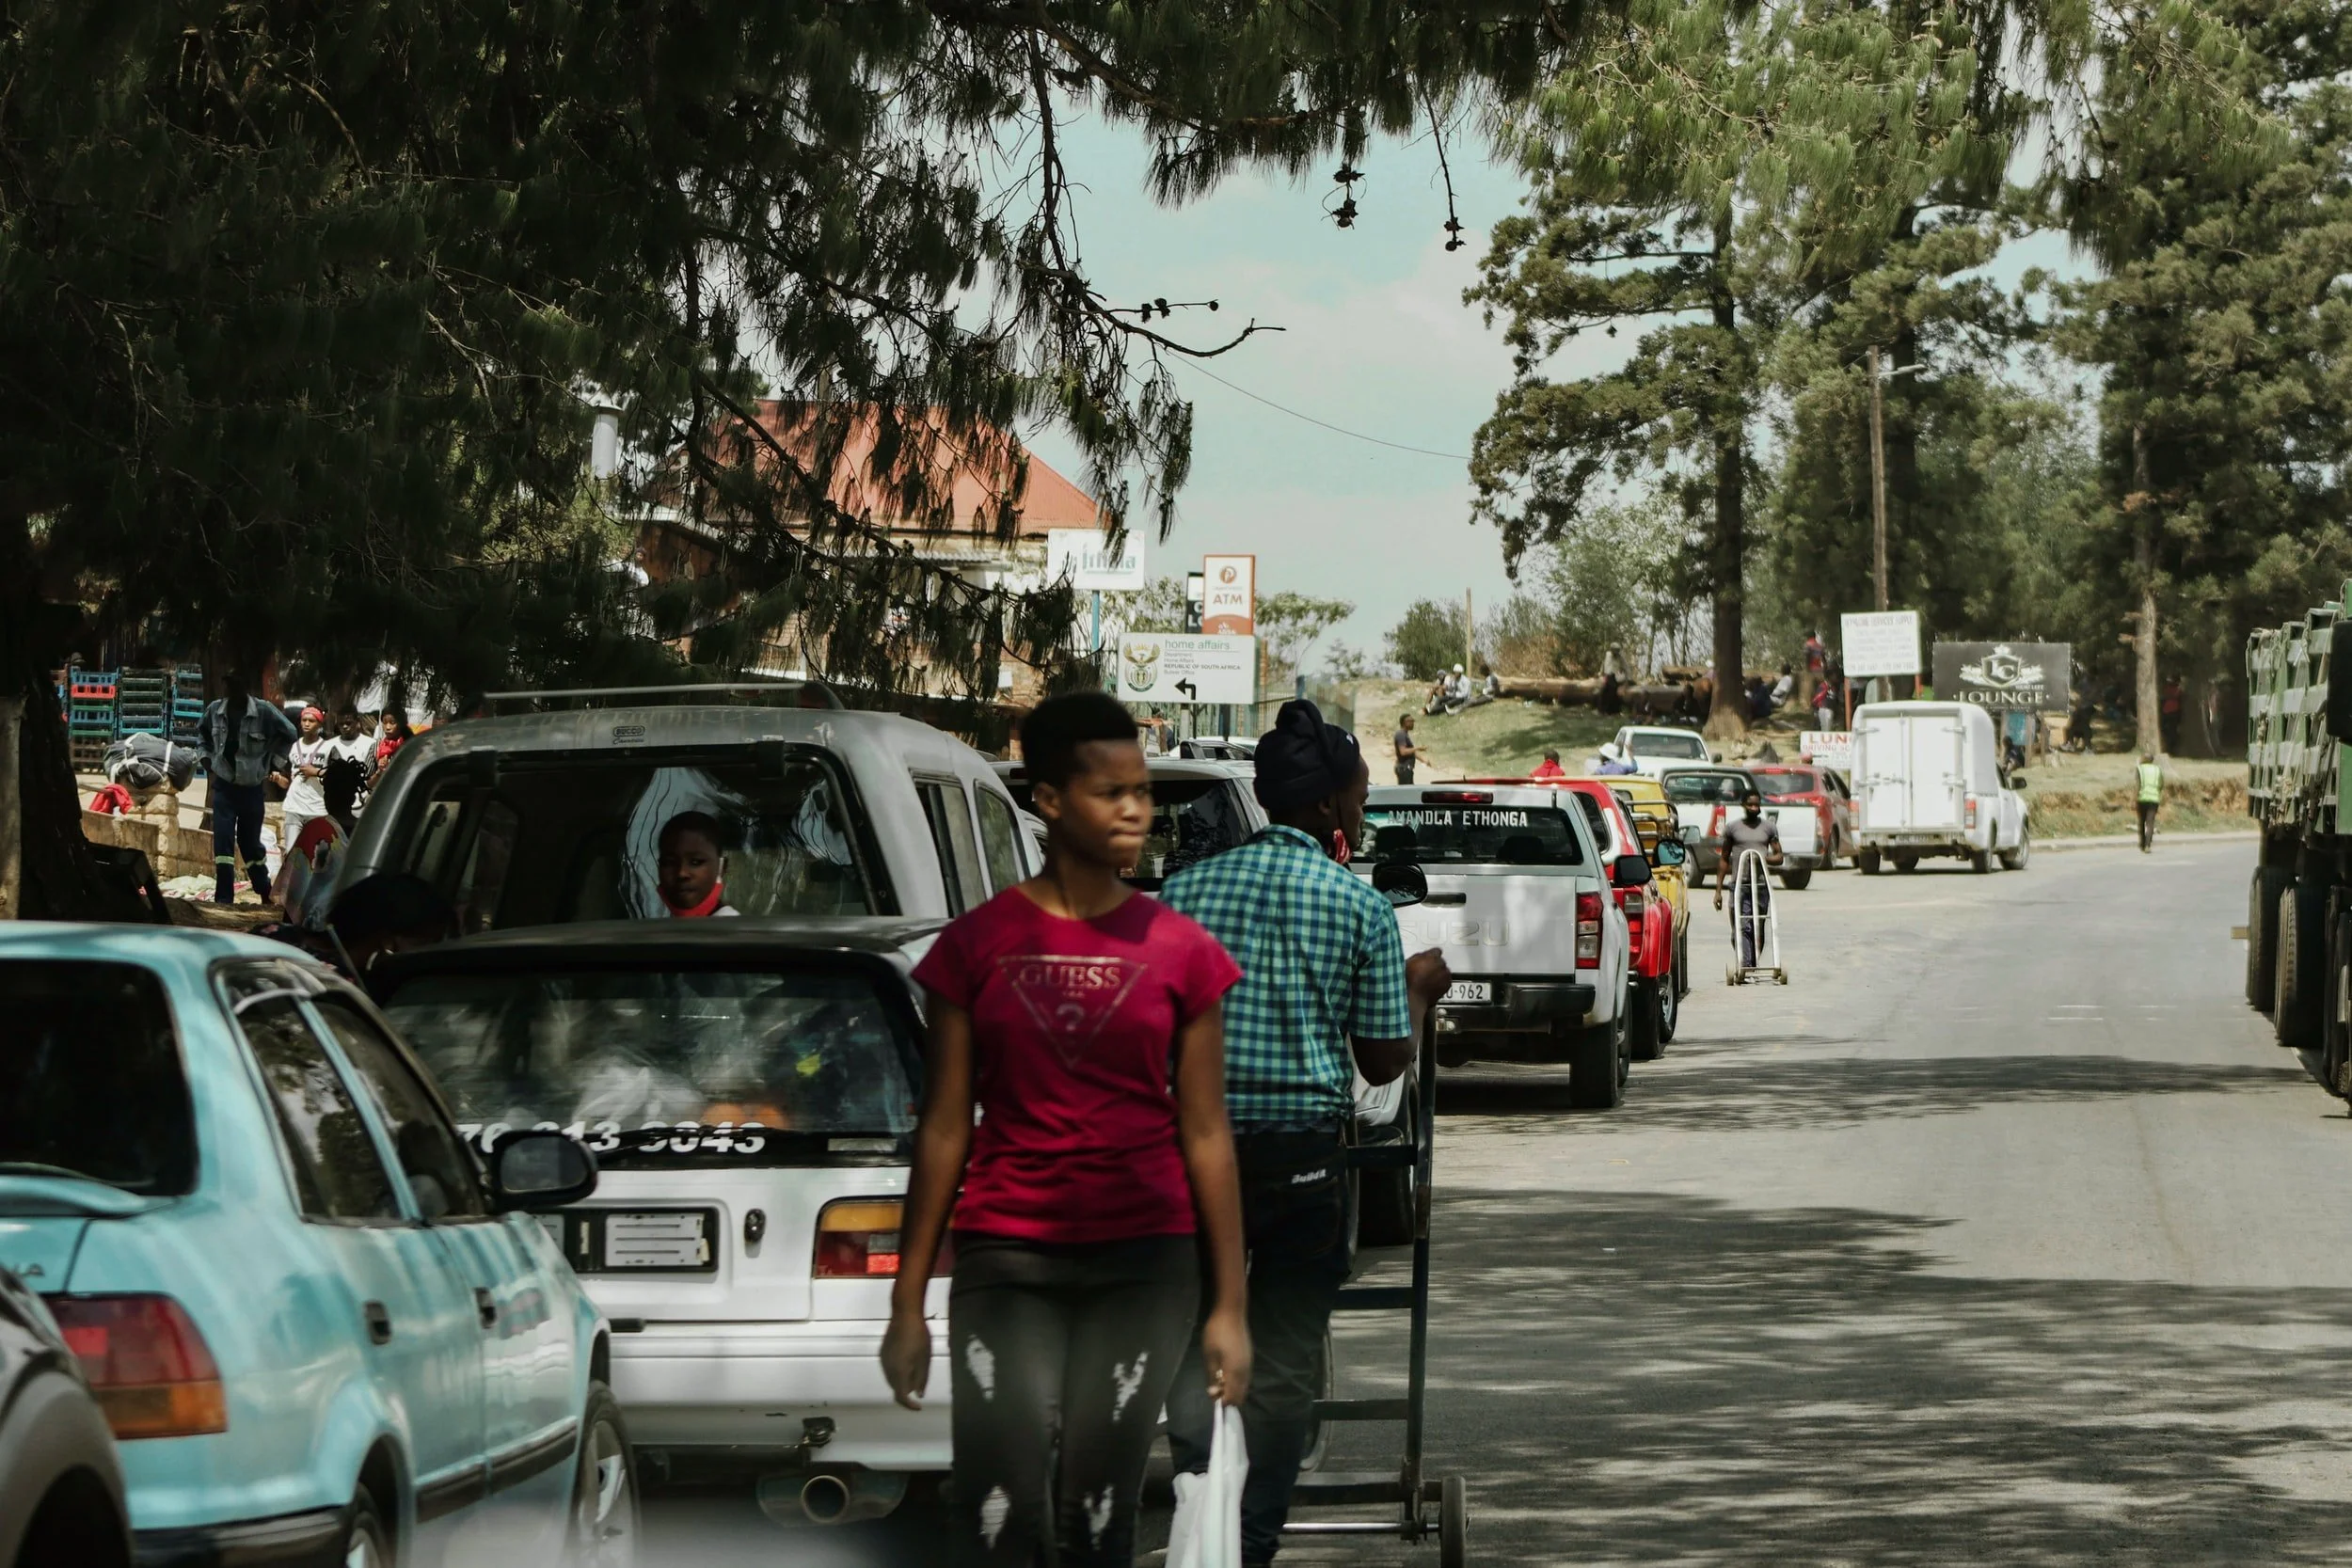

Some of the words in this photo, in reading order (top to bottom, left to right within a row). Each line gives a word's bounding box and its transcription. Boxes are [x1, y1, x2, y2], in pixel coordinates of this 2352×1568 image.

[1213, 594, 1243, 605] ATM
[1165, 640, 1195, 649] home
[1198, 640, 1231, 650] affairs
[1808, 734, 1851, 744] LUN
[1387, 810, 1453, 826] AMANDLA
[1462, 811, 1529, 828] ETHONGA
[1019, 963, 1121, 990] GUESS
